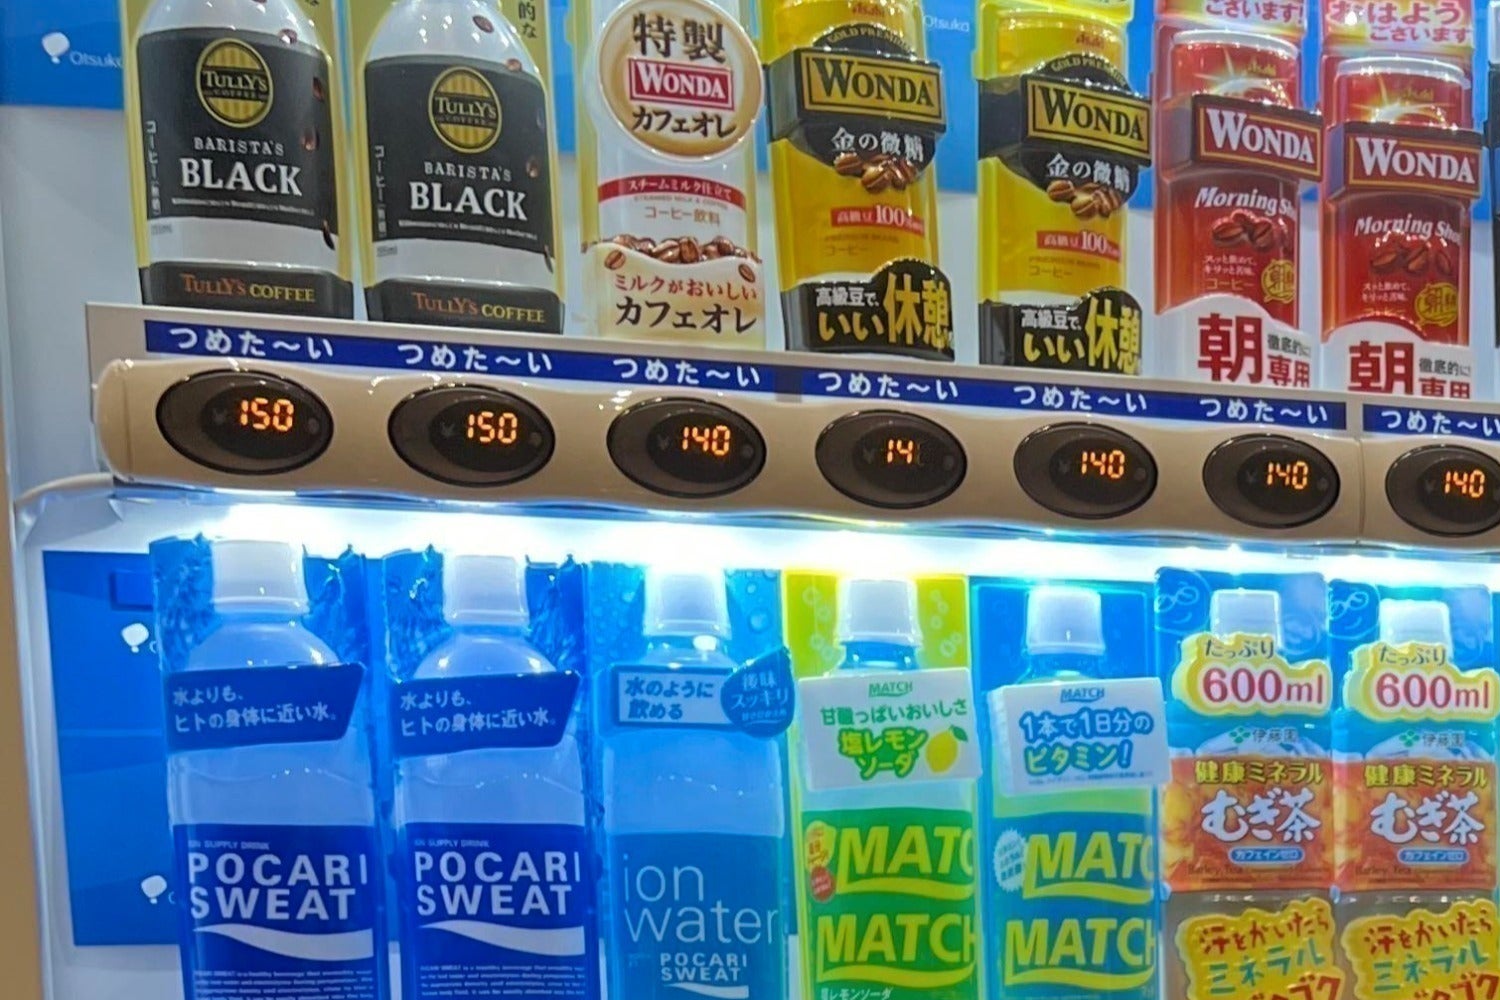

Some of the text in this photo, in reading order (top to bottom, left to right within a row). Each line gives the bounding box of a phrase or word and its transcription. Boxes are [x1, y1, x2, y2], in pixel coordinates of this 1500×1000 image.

[633, 14, 727, 63] 特製
[636, 61, 726, 99] WONDA
[812, 58, 935, 107] WONDA
[632, 107, 737, 138] カフェオレ
[1037, 84, 1146, 141] WONDA
[193, 137, 284, 156] BARISTA'S
[831, 127, 924, 162] 金の微糖
[1205, 107, 1315, 164] WONDA
[424, 161, 512, 182] BARISTA'S
[1046, 152, 1131, 193] 金の微糖
[1356, 136, 1476, 184] WONDA
[180, 158, 302, 196] BLACK
[409, 181, 527, 221] BLACK
[645, 206, 721, 226] コーヒー飲料
[1194, 186, 1278, 217] Morning
[248, 284, 315, 303] COFFEE
[615, 274, 757, 301] ミルクがおいしい
[481, 303, 545, 324] COFFEE
[616, 298, 757, 333] カフェオレ
[1197, 312, 1264, 384] 朝
[1267, 348, 1312, 389] 専用
[1348, 340, 1414, 395] 朝
[240, 398, 295, 432] 150
[467, 412, 518, 444] 150
[681, 424, 731, 456] 140
[1081, 449, 1125, 479] 140
[1266, 460, 1308, 490] 140
[1443, 469, 1485, 498] 140
[1204, 639, 1275, 659] たっぷり
[1379, 646, 1448, 666] たっぷり
[625, 676, 714, 698] 水のように
[869, 681, 913, 697] MATCH
[1060, 687, 1105, 702] MATCH
[1202, 667, 1323, 704] 600ml
[1375, 672, 1490, 709] 600ml
[174, 703, 338, 733] ヒトの身体に近い水。
[402, 706, 558, 736] ヒトの身体に近い水。
[628, 699, 683, 719] 飲める
[821, 698, 968, 726] 甘酸っぱいおいしさ
[1020, 708, 1153, 742] 1本で1日分の
[1252, 728, 1299, 743] 伊藤園
[1027, 741, 1132, 774] ビタミン!
[1195, 760, 1324, 786] 健康ミネラル
[1364, 764, 1488, 789] 健康ミネラル
[1201, 787, 1321, 843] むぎ茶
[1370, 790, 1485, 845] むぎ茶
[188, 851, 368, 886] POCARI
[414, 850, 581, 883] POCARI
[624, 852, 705, 902] ion
[189, 886, 357, 920] SWEAT
[416, 884, 572, 916] SWEAT
[624, 900, 779, 945] water
[1199, 905, 1329, 955] 汗をかいたら
[1363, 905, 1492, 956] 汗をかいたら
[660, 953, 747, 968] POCARI
[660, 968, 741, 982] SWEAT
[1208, 938, 1325, 995] ミネラル
[1373, 939, 1488, 993] ミネラル
